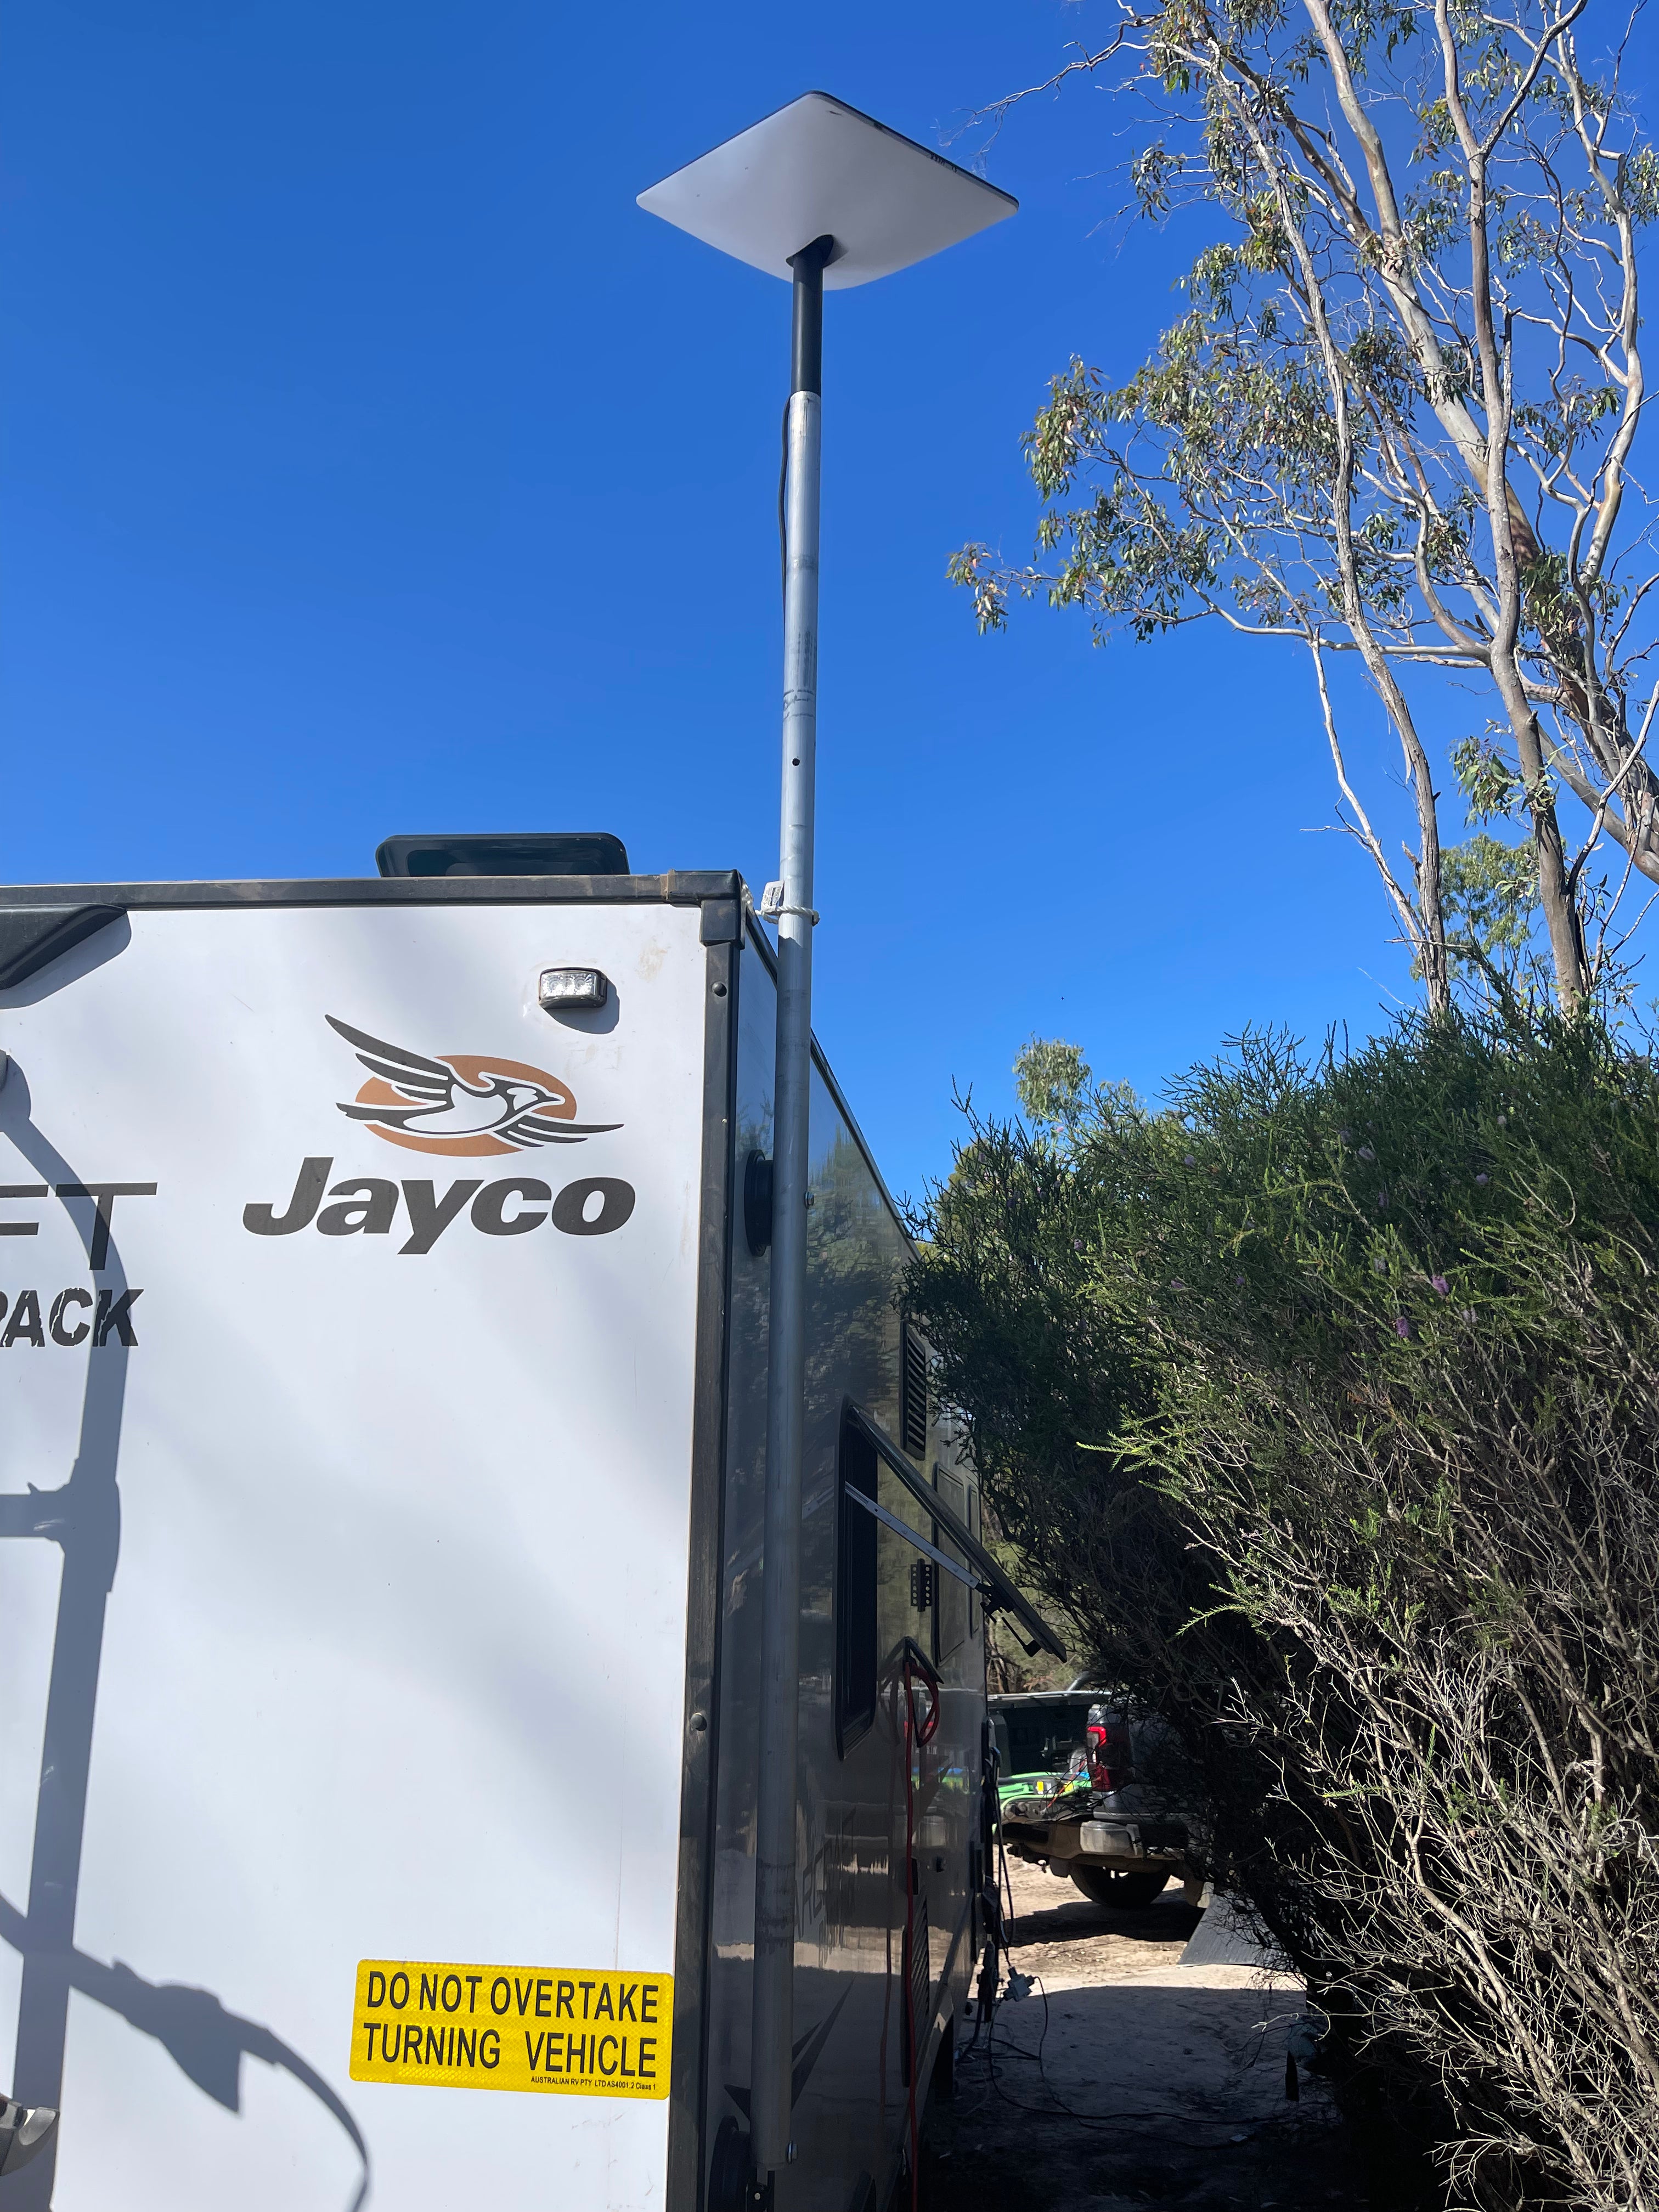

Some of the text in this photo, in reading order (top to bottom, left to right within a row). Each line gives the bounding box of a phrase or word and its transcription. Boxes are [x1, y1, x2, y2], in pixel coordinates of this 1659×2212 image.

[243, 1157, 636, 1255] Jayco
[0, 1288, 144, 1347] ACK
[367, 1971, 659, 2023] DO NOT OVERTAKE
[363, 2022, 657, 2078] TURNING VEHICLE
[531, 2075, 569, 2085] AUSTRALIAN
[571, 2078, 579, 2086] RV
